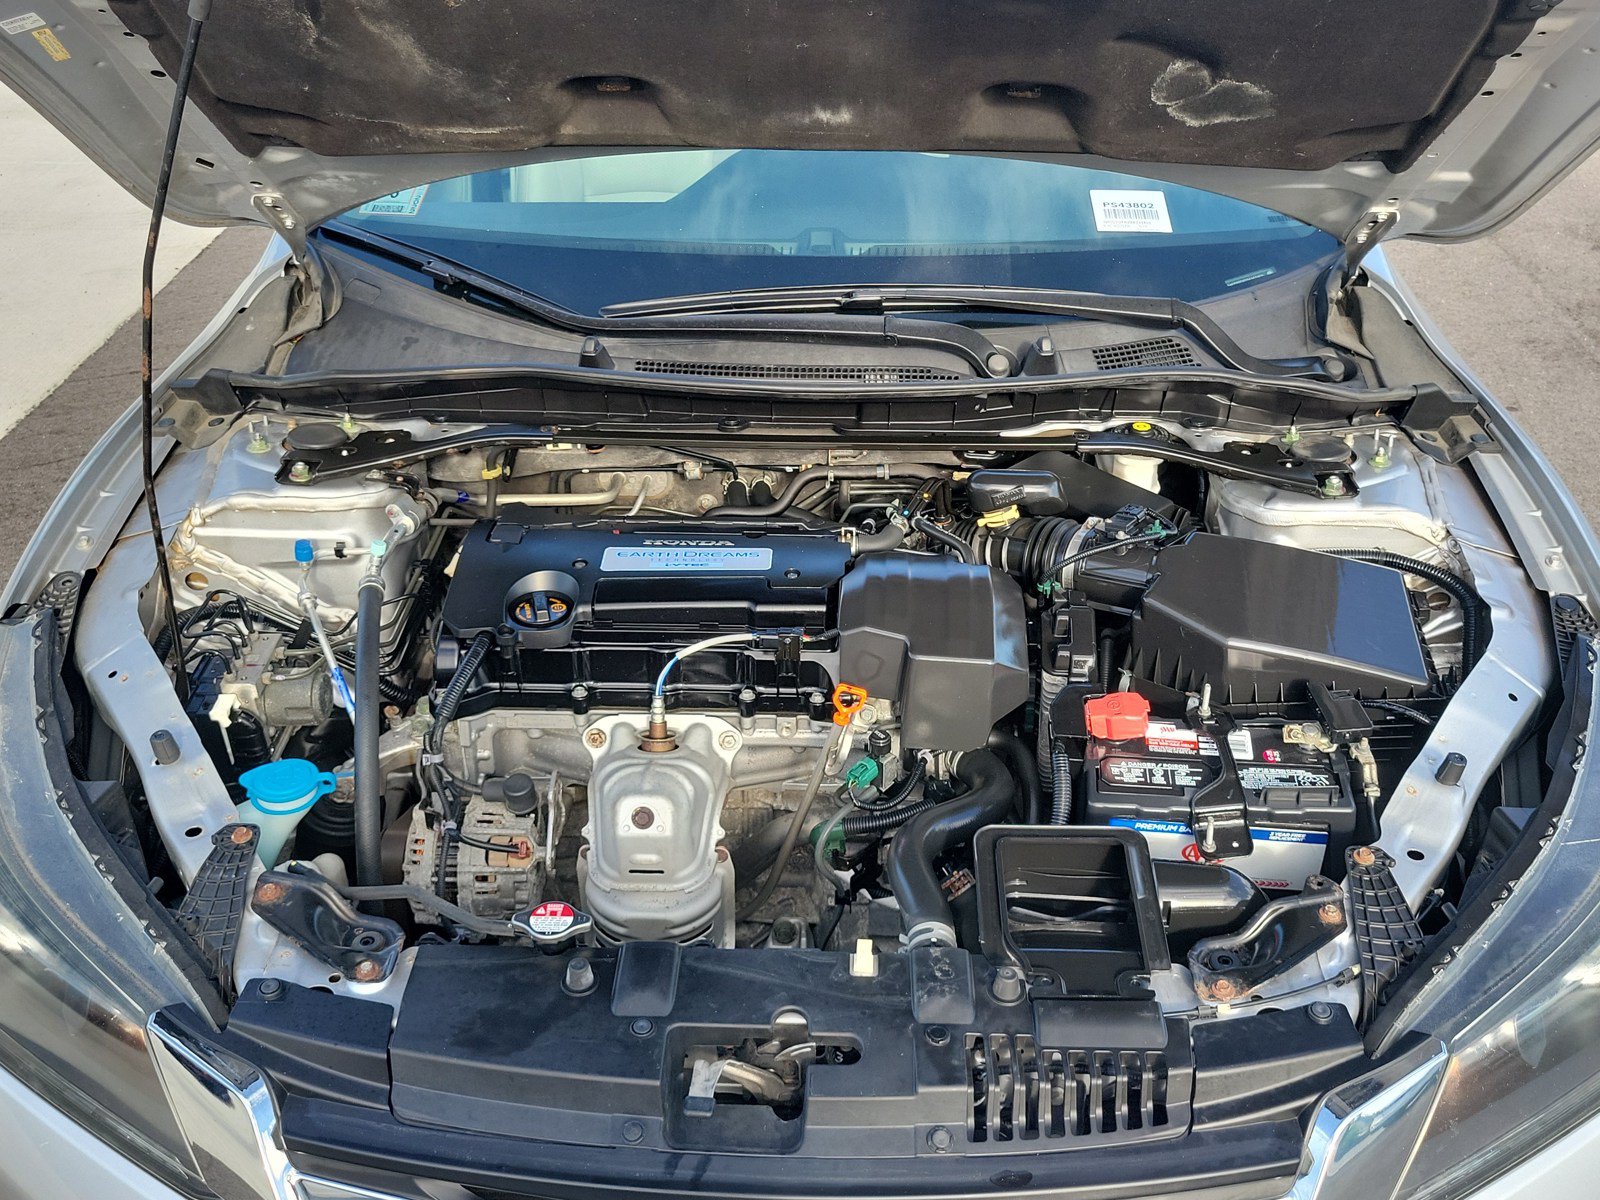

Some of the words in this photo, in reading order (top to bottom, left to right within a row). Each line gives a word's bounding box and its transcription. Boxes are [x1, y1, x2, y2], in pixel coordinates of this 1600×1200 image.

[683, 550, 760, 558] DREAMS
[1128, 761, 1156, 769] DANGER
[1134, 822, 1178, 832] PREMIUM
